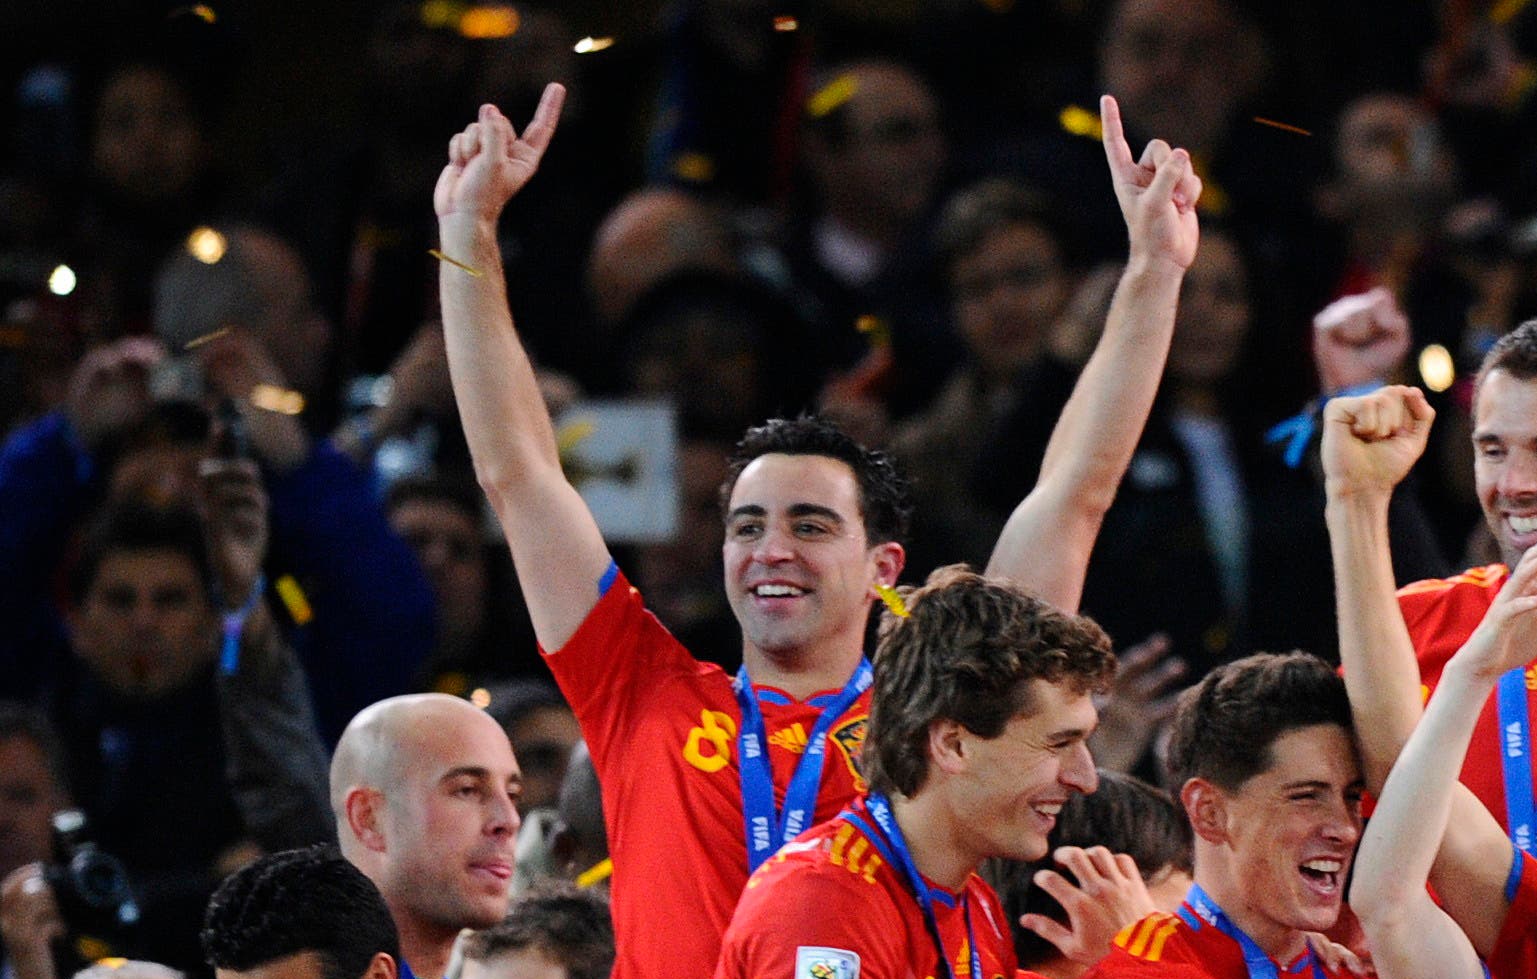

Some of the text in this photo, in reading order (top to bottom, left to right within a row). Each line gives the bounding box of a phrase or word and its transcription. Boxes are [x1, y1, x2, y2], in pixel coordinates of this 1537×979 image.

[683, 709, 736, 772] 8
[1506, 721, 1522, 757] FIFA
[752, 817, 770, 851] FIFA
[784, 809, 804, 842] FIFA
